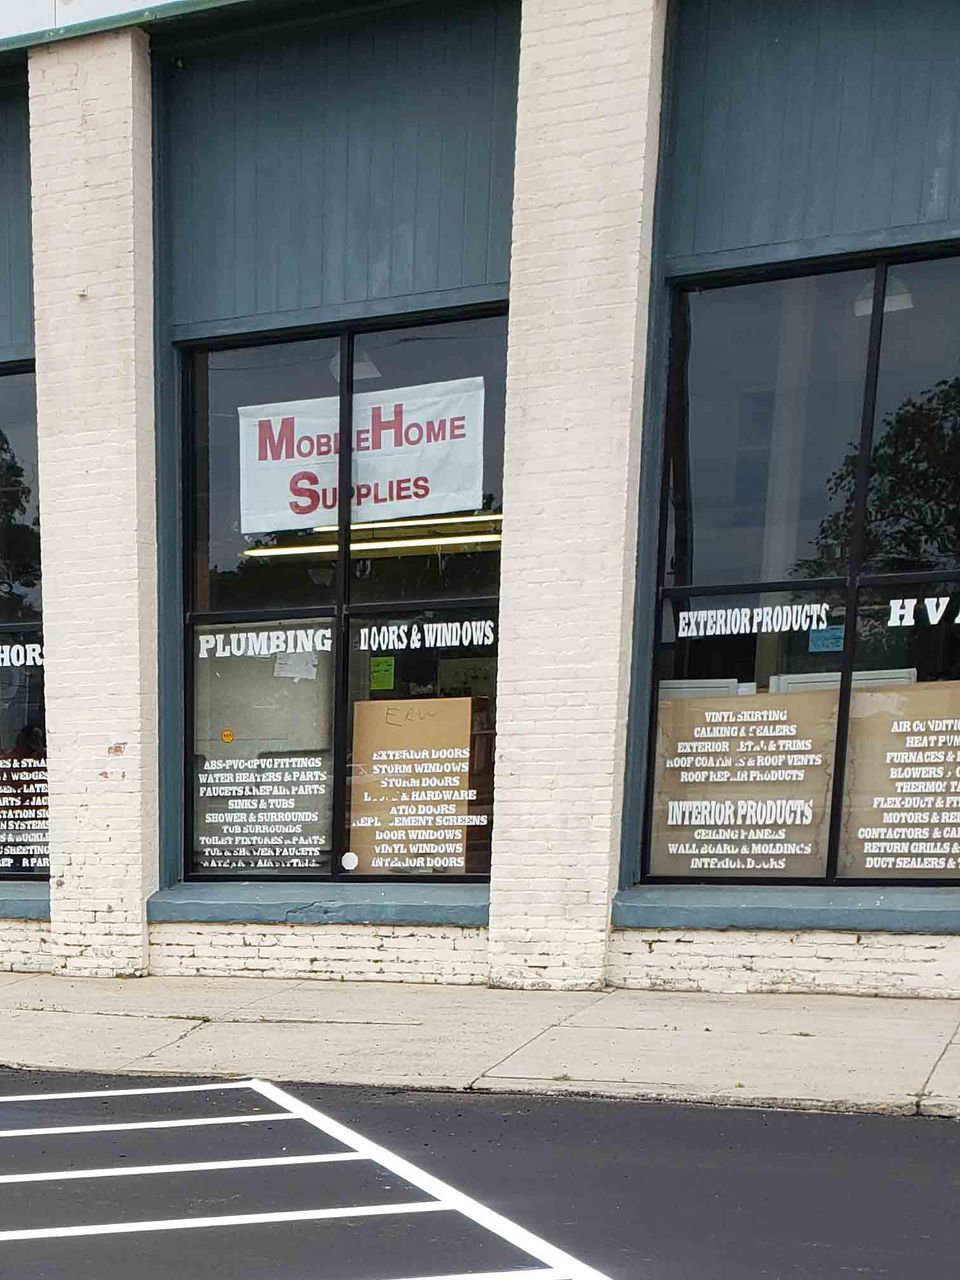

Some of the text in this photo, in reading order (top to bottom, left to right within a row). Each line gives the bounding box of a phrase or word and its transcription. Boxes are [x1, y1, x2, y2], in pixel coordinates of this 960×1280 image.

[257, 403, 466, 462] MOBIE HOME
[289, 470, 431, 515] SUPLIES
[678, 602, 829, 637] EXTERIOR PRODUCTS
[359, 620, 495, 651] DOORS & WINDOWS
[198, 628, 333, 659] PLUMBING
[705, 710, 788, 722] VINYL SKIRTING
[694, 726, 738, 738] CALKING
[749, 725, 797, 737] SEALERS
[891, 720, 911, 732] AIR
[677, 741, 730, 753] EXTERIOR
[778, 739, 812, 751] TRIMS
[905, 736, 937, 748] HEAT
[372, 748, 470, 760] EXTERIOR DOORS
[756, 755, 785, 766] ROOF
[787, 754, 823, 766] VENTS
[886, 751, 944, 763] FURNACES
[946, 751, 955, 762] &
[273, 757, 322, 768] FITTINGS
[372, 762, 469, 774] STORM WINDOWS
[198, 771, 327, 783] WATER HEATERS & PARTS
[680, 769, 805, 782] ROOF REPIR PRODUCTS
[890, 767, 944, 779] BLOWERS
[421, 776, 460, 787] DOORS
[199, 786, 244, 797] FAUCETS
[291, 784, 326, 795] PARTS
[410, 790, 477, 801] HARDWARE
[228, 798, 295, 810] SINKS & TUBS
[872, 797, 935, 808] FLEX-DUCT
[417, 804, 457, 814] DOORS
[667, 799, 814, 826] INTERIOR PRODUCTS
[205, 811, 319, 823] SHOWER & SURROUNDS
[435, 815, 488, 826] SCREENS
[883, 812, 930, 824] MOTORS
[221, 824, 302, 834] TUB SURROUNDS
[375, 829, 463, 840] DOOR WINDOWS
[694, 829, 739, 840] CEILING
[858, 827, 930, 839] CONTACTORS
[199, 836, 234, 845] TOILET
[374, 843, 463, 854] VINYL WINDOWS
[667, 843, 699, 854] WALL
[751, 842, 812, 854] MOLDINGS
[863, 842, 910, 853] RETURN
[910, 842, 951, 854] GRILLS
[426, 856, 465, 867] DOORS
[865, 857, 895, 868] DUCT
[895, 857, 945, 869] SEALERS
